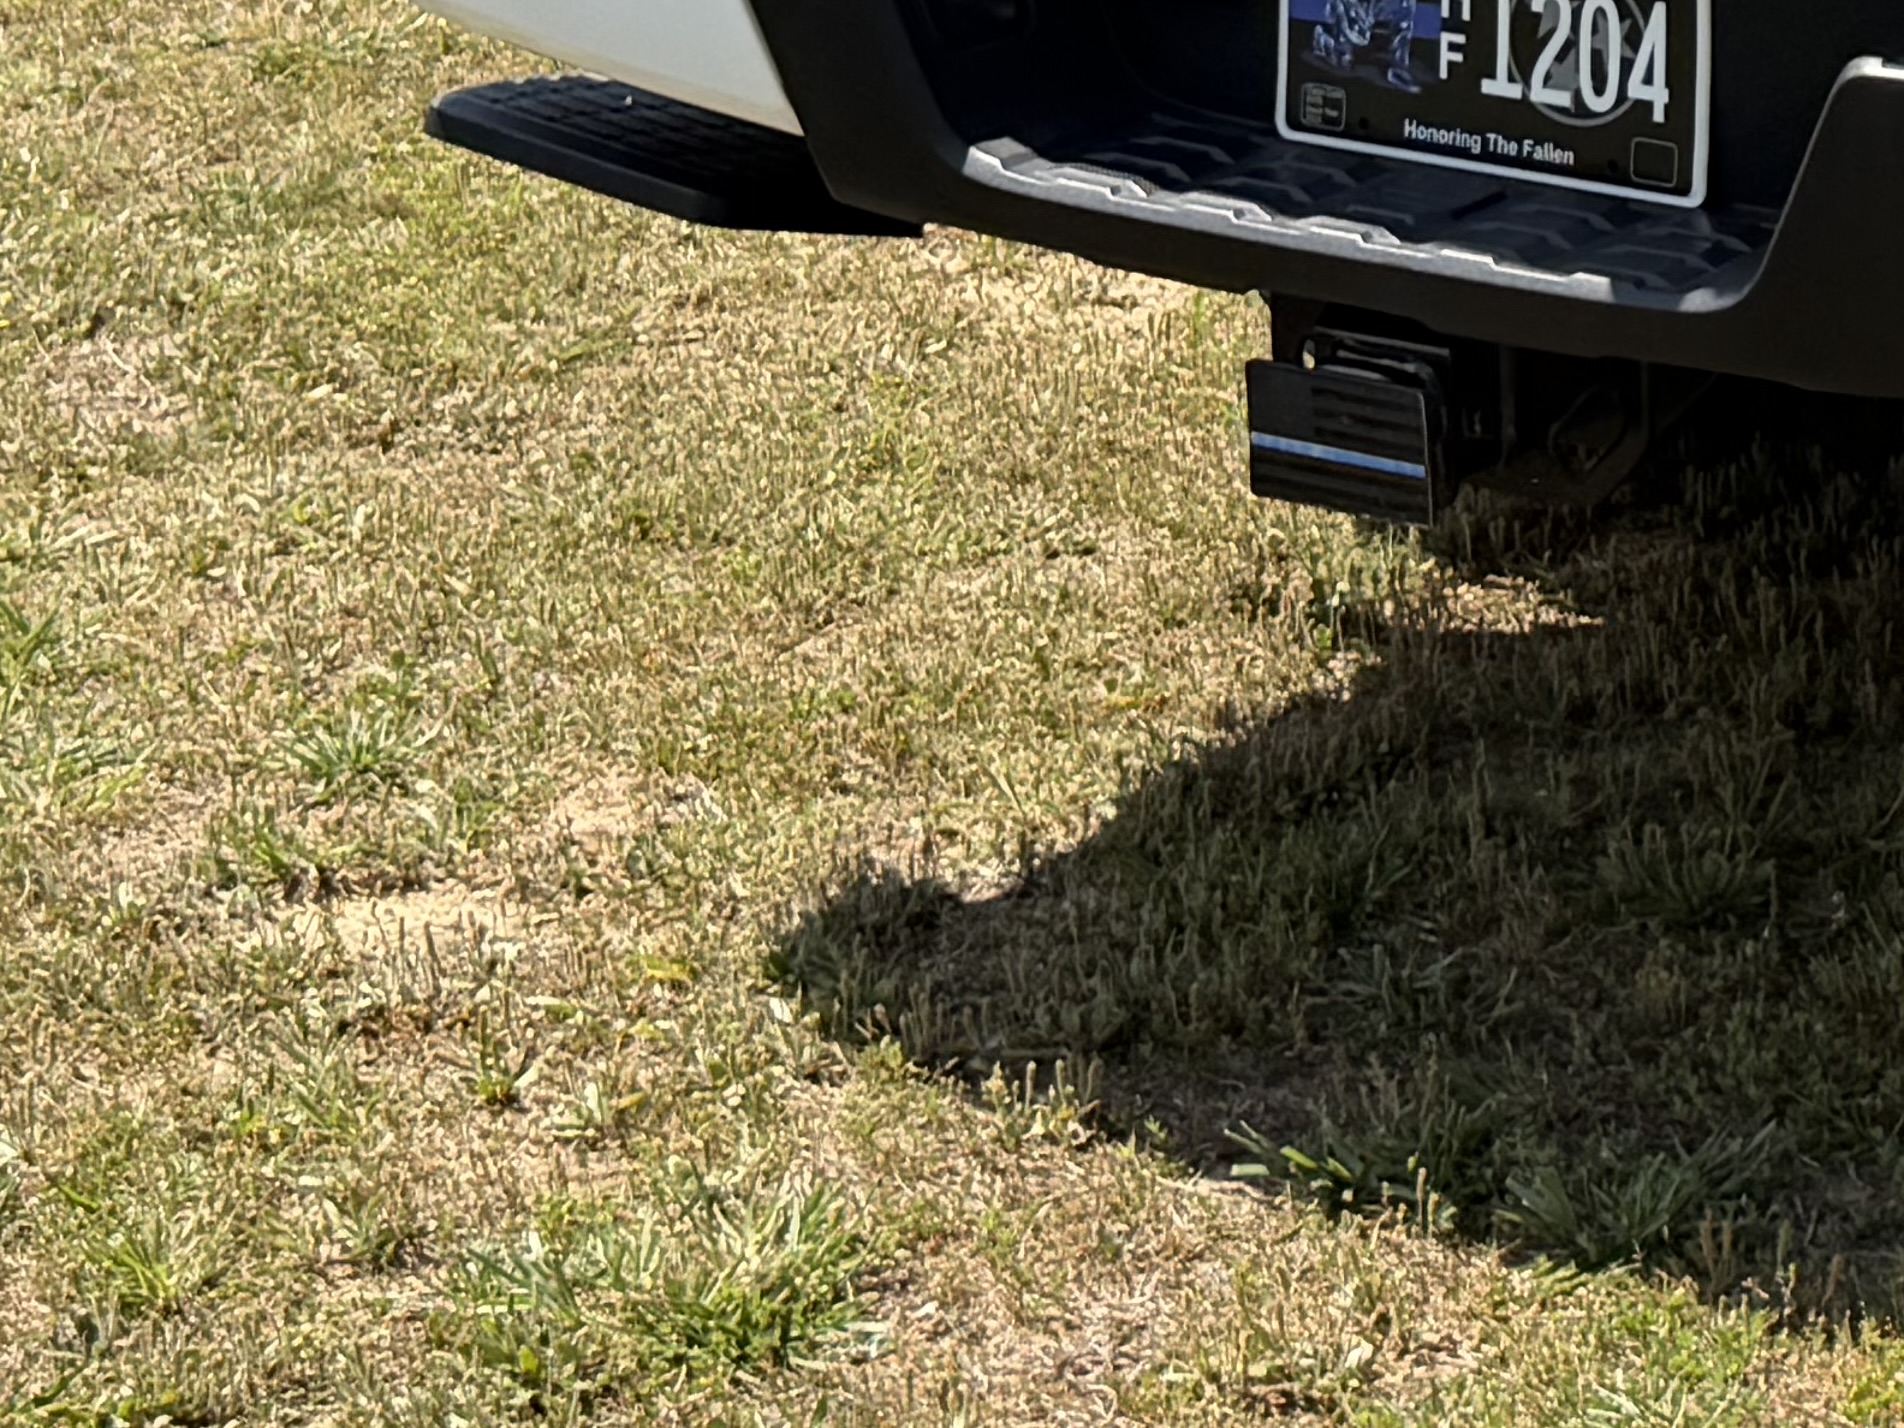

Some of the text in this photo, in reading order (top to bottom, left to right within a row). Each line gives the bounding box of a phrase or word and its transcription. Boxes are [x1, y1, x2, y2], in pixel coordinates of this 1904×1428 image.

[1403, 118, 1575, 165] Honoring The Fallen
